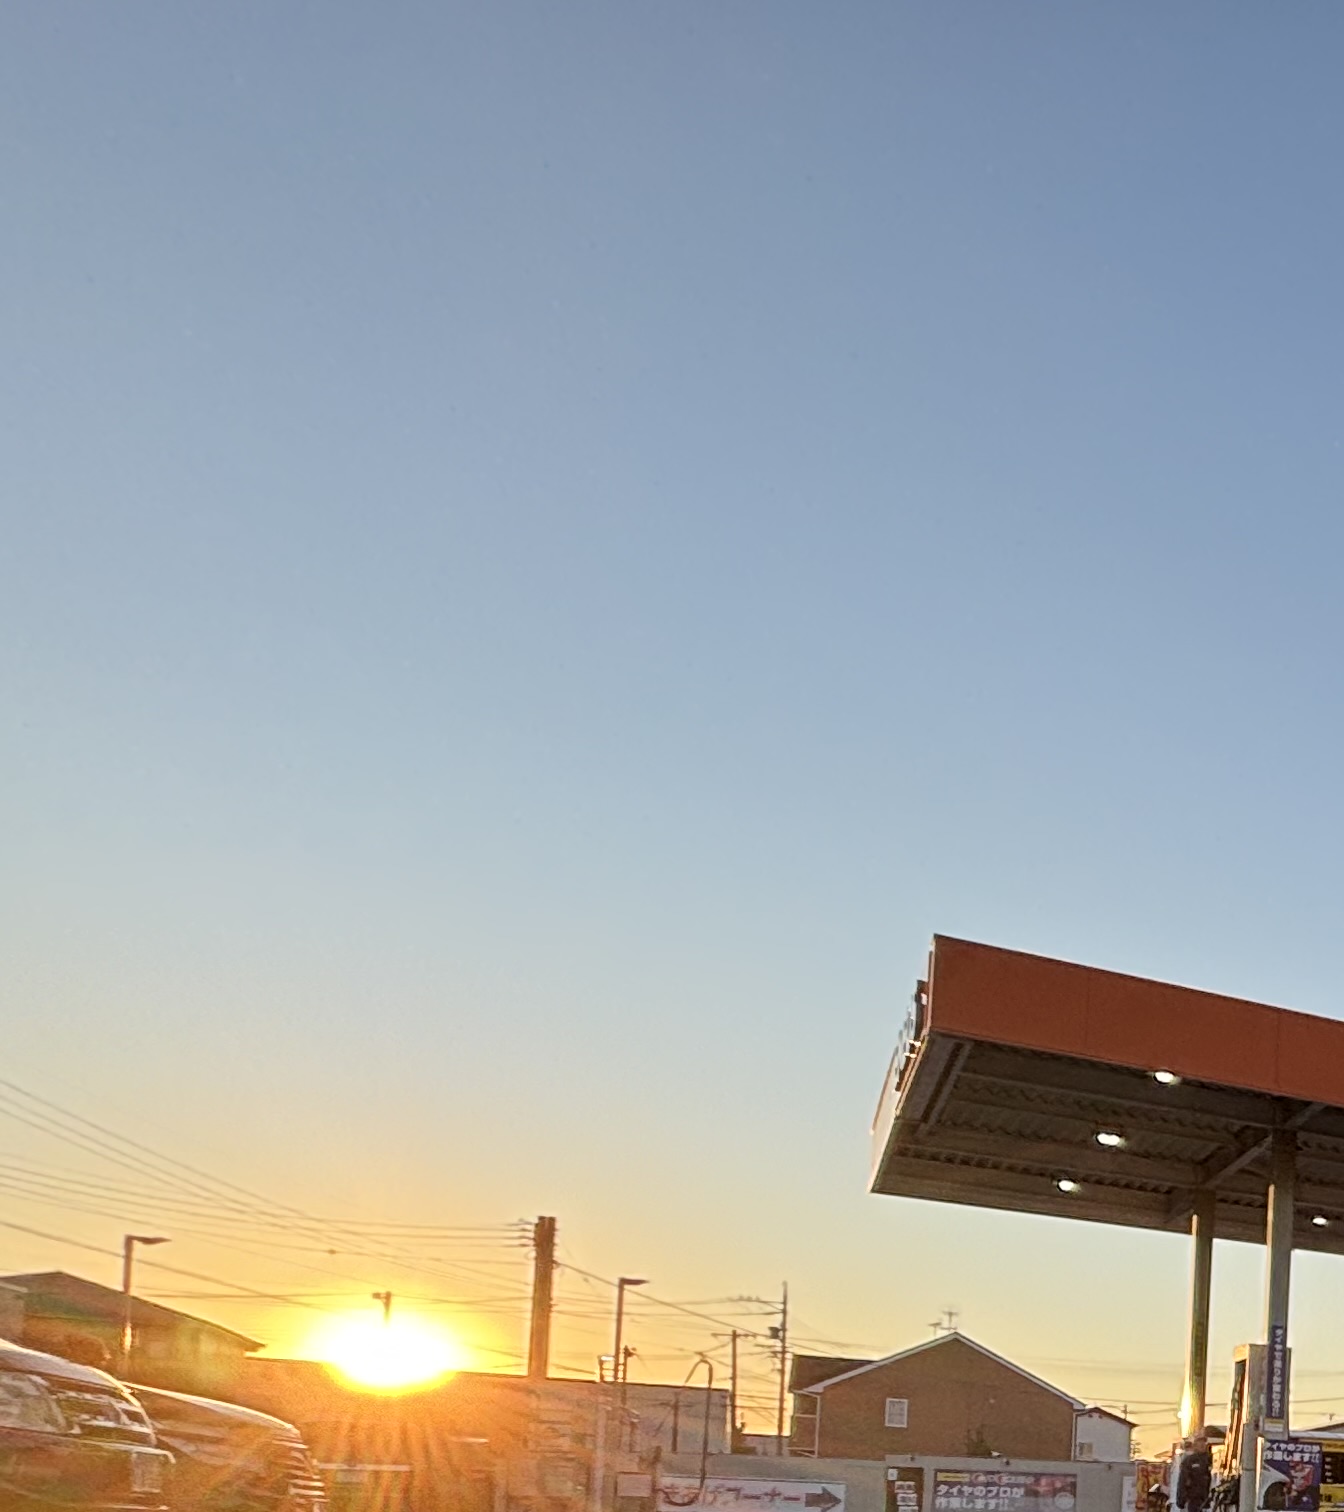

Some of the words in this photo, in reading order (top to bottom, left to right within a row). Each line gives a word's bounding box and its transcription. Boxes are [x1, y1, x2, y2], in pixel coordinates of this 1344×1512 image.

[936, 1484, 1025, 1498] タイヤのプロが
